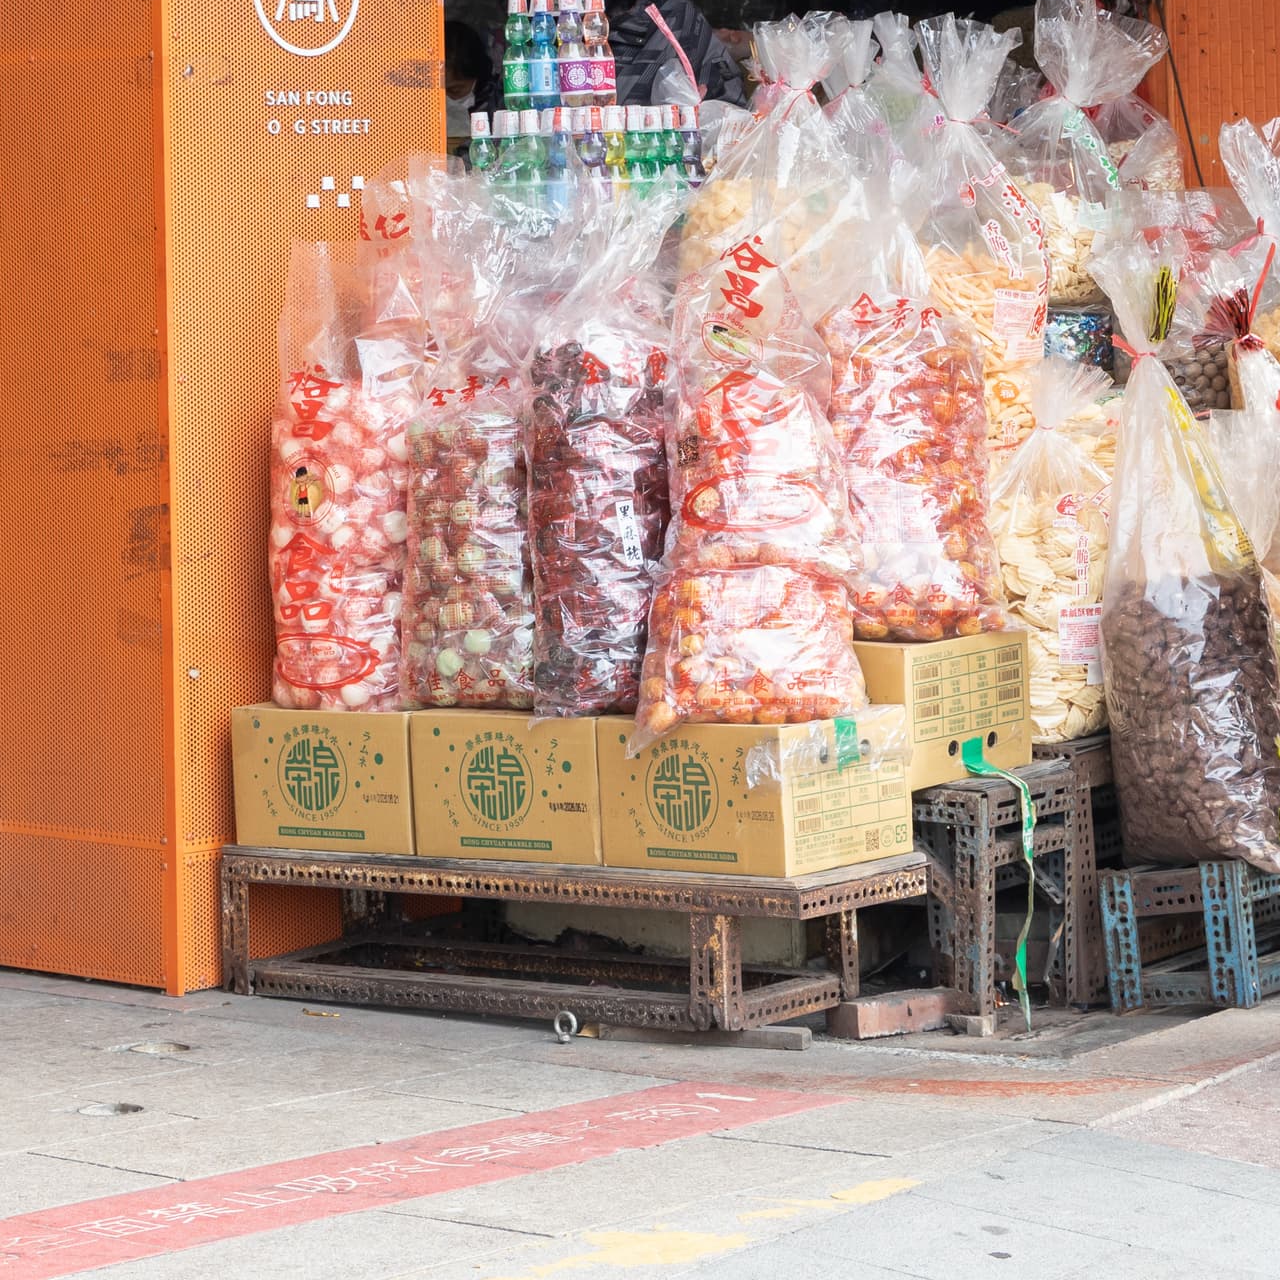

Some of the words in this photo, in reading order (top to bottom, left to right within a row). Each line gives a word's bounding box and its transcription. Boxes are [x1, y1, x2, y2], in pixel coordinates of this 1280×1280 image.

[265, 91, 300, 106] SAN
[306, 91, 352, 106] FONG
[311, 119, 370, 135] STREET
[287, 364, 344, 441] 裕昌
[278, 533, 340, 621] 食品
[673, 666, 840, 696] 美佳食品行
[359, 732, 372, 768] ラムネ
[546, 738, 558, 776] ラムネ
[731, 747, 744, 786] ラムネ
[288, 804, 317, 822] SINCE
[320, 806, 338, 821] 1959
[471, 814, 502, 832] SINCE
[505, 815, 524, 831] 1959
[658, 824, 688, 843] SINCE
[690, 827, 710, 842] 1959
